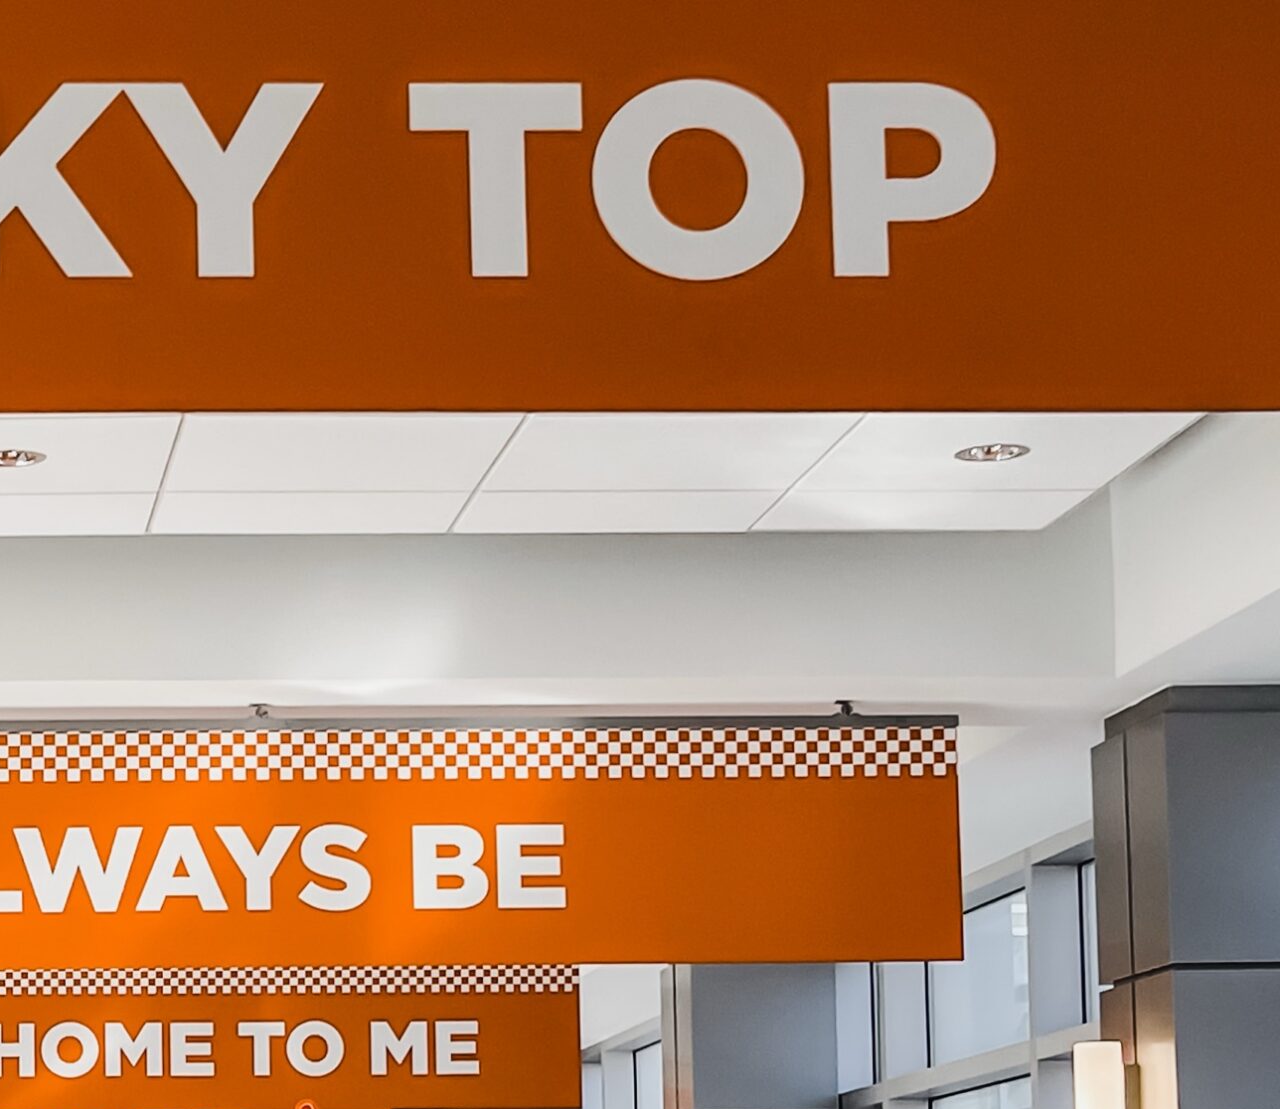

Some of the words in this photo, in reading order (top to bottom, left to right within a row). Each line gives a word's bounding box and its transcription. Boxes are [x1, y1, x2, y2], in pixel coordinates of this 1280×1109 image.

[408, 78, 997, 281] TOP
[412, 824, 567, 909] BE
[237, 1020, 344, 1077] TO
[370, 1020, 480, 1076] ME
